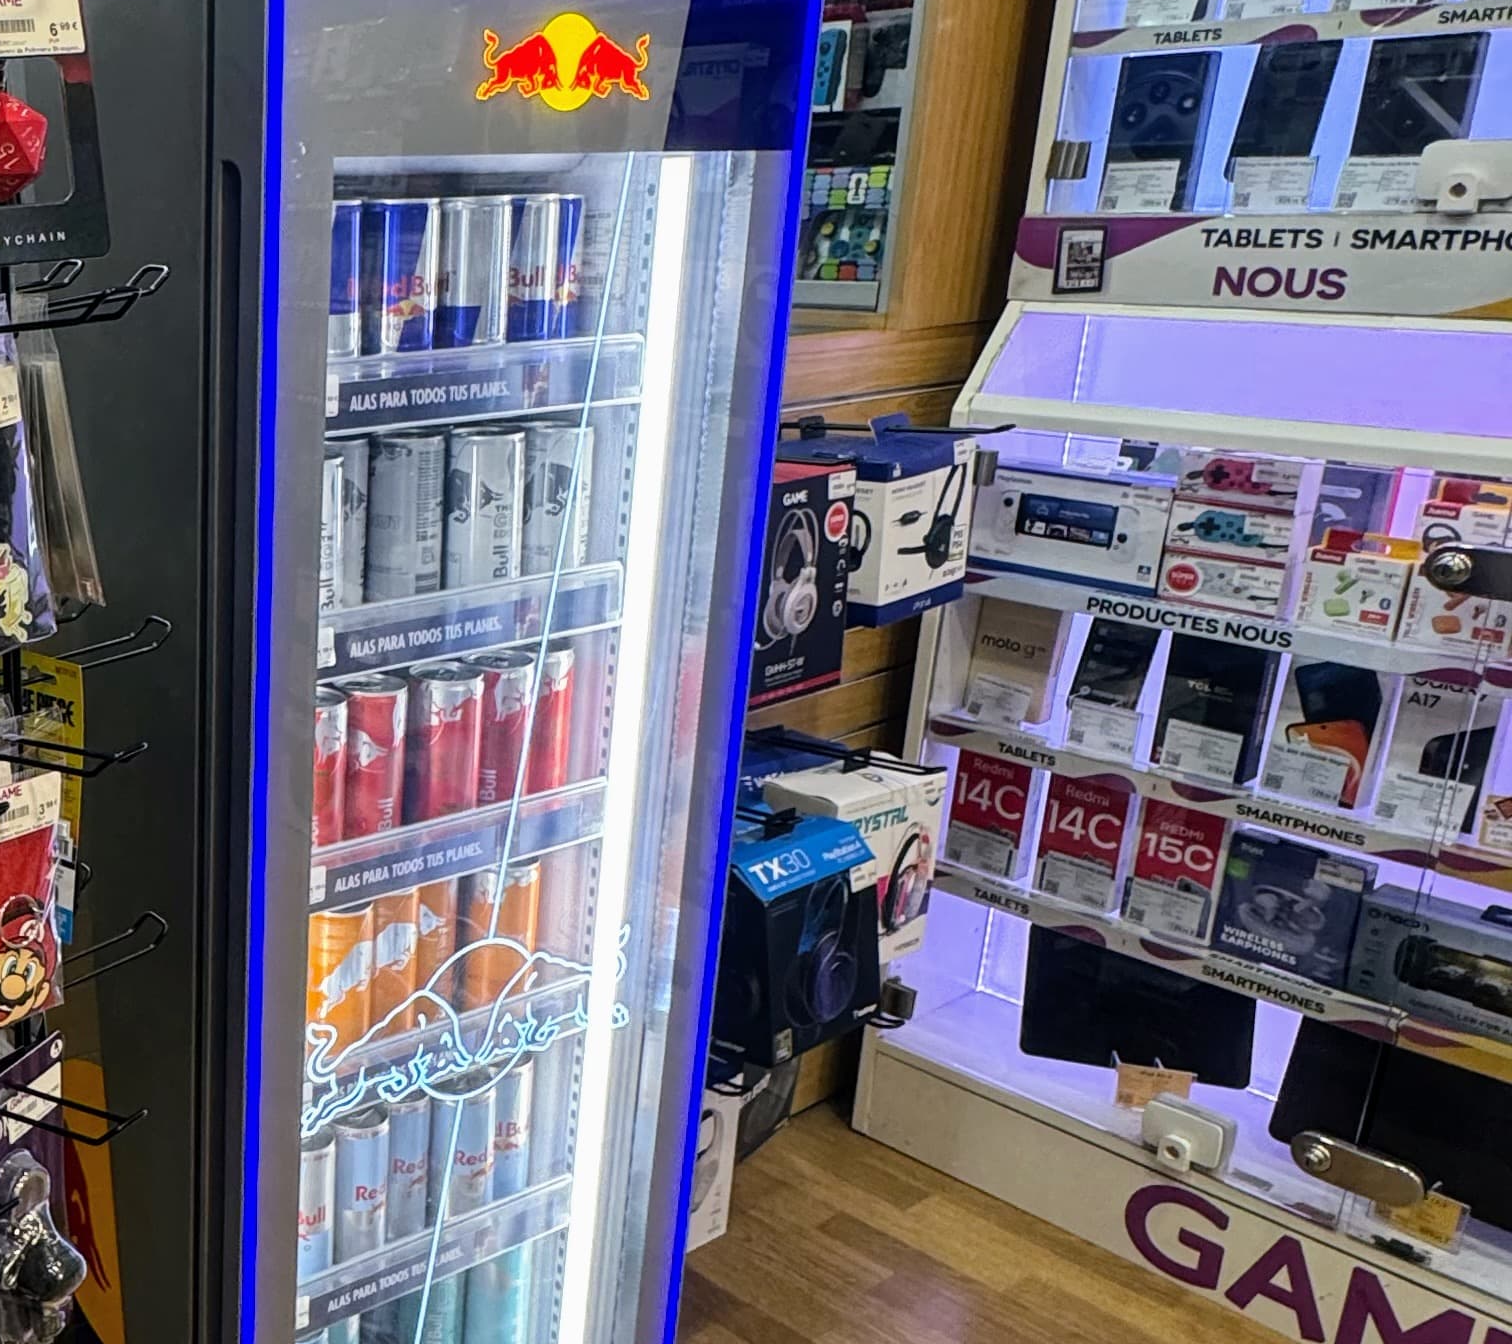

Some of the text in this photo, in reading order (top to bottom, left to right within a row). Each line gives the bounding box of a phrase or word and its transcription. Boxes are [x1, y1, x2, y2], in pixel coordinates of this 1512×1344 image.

[1154, 28, 1222, 45] TABLETS
[1201, 227, 1323, 250] TABLETS
[1212, 264, 1347, 300] NOUS
[350, 380, 510, 411] ALAS PARA TODOS TUS PLANES.
[783, 490, 808, 506] GAME
[1087, 598, 1291, 648] PRODUCTES NOUS
[350, 639, 375, 658] ALAS
[379, 635, 406, 653] PARA
[408, 627, 442, 648] TODOS
[445, 624, 463, 643] TUS
[981, 635, 1020, 652] moto
[1408, 693, 1441, 708] A17
[974, 758, 1015, 773] Redmi
[999, 743, 1056, 766] TABLETS
[959, 772, 1024, 820] 14C
[1066, 786, 1109, 806] Redmi
[1048, 799, 1122, 849] 14C
[1160, 822, 1204, 841] REDMI
[1236, 804, 1366, 846] SMARTPHONES
[747, 850, 810, 885] TX30
[1144, 833, 1214, 871] 15C
[335, 875, 360, 892] ALAS
[363, 868, 389, 886] PARA
[392, 860, 424, 881] TODOS
[428, 855, 445, 872] TUS
[974, 887, 1029, 915] TABLETS
[1221, 933, 1296, 965] EARPHONES
[1222, 924, 1284, 951] WIRELESS
[1201, 965, 1325, 1015] SMARTPHONES
[327, 1294, 351, 1312] ALAS
[353, 1283, 377, 1303] PARA
[379, 1272, 409, 1294] TODOS
